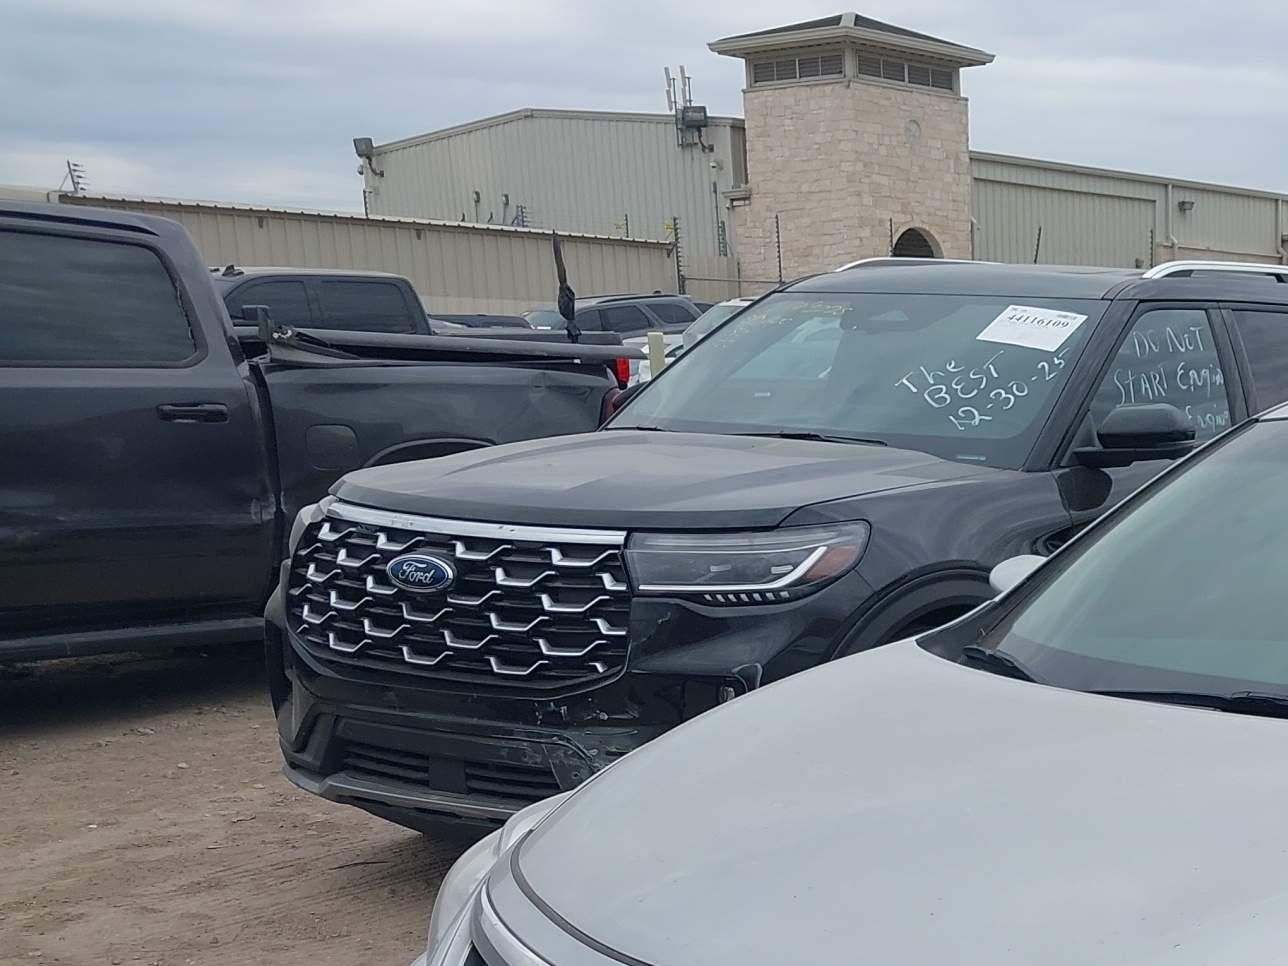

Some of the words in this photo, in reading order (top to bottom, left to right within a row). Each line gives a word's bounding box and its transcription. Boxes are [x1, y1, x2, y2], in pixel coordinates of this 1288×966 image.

[1008, 314, 1070, 328] 44116109
[1166, 327, 1205, 353] NOT
[894, 359, 966, 393] The
[923, 350, 1004, 408] BEST
[948, 347, 1071, 430] 12-30-25
[399, 560, 436, 584] Ford
